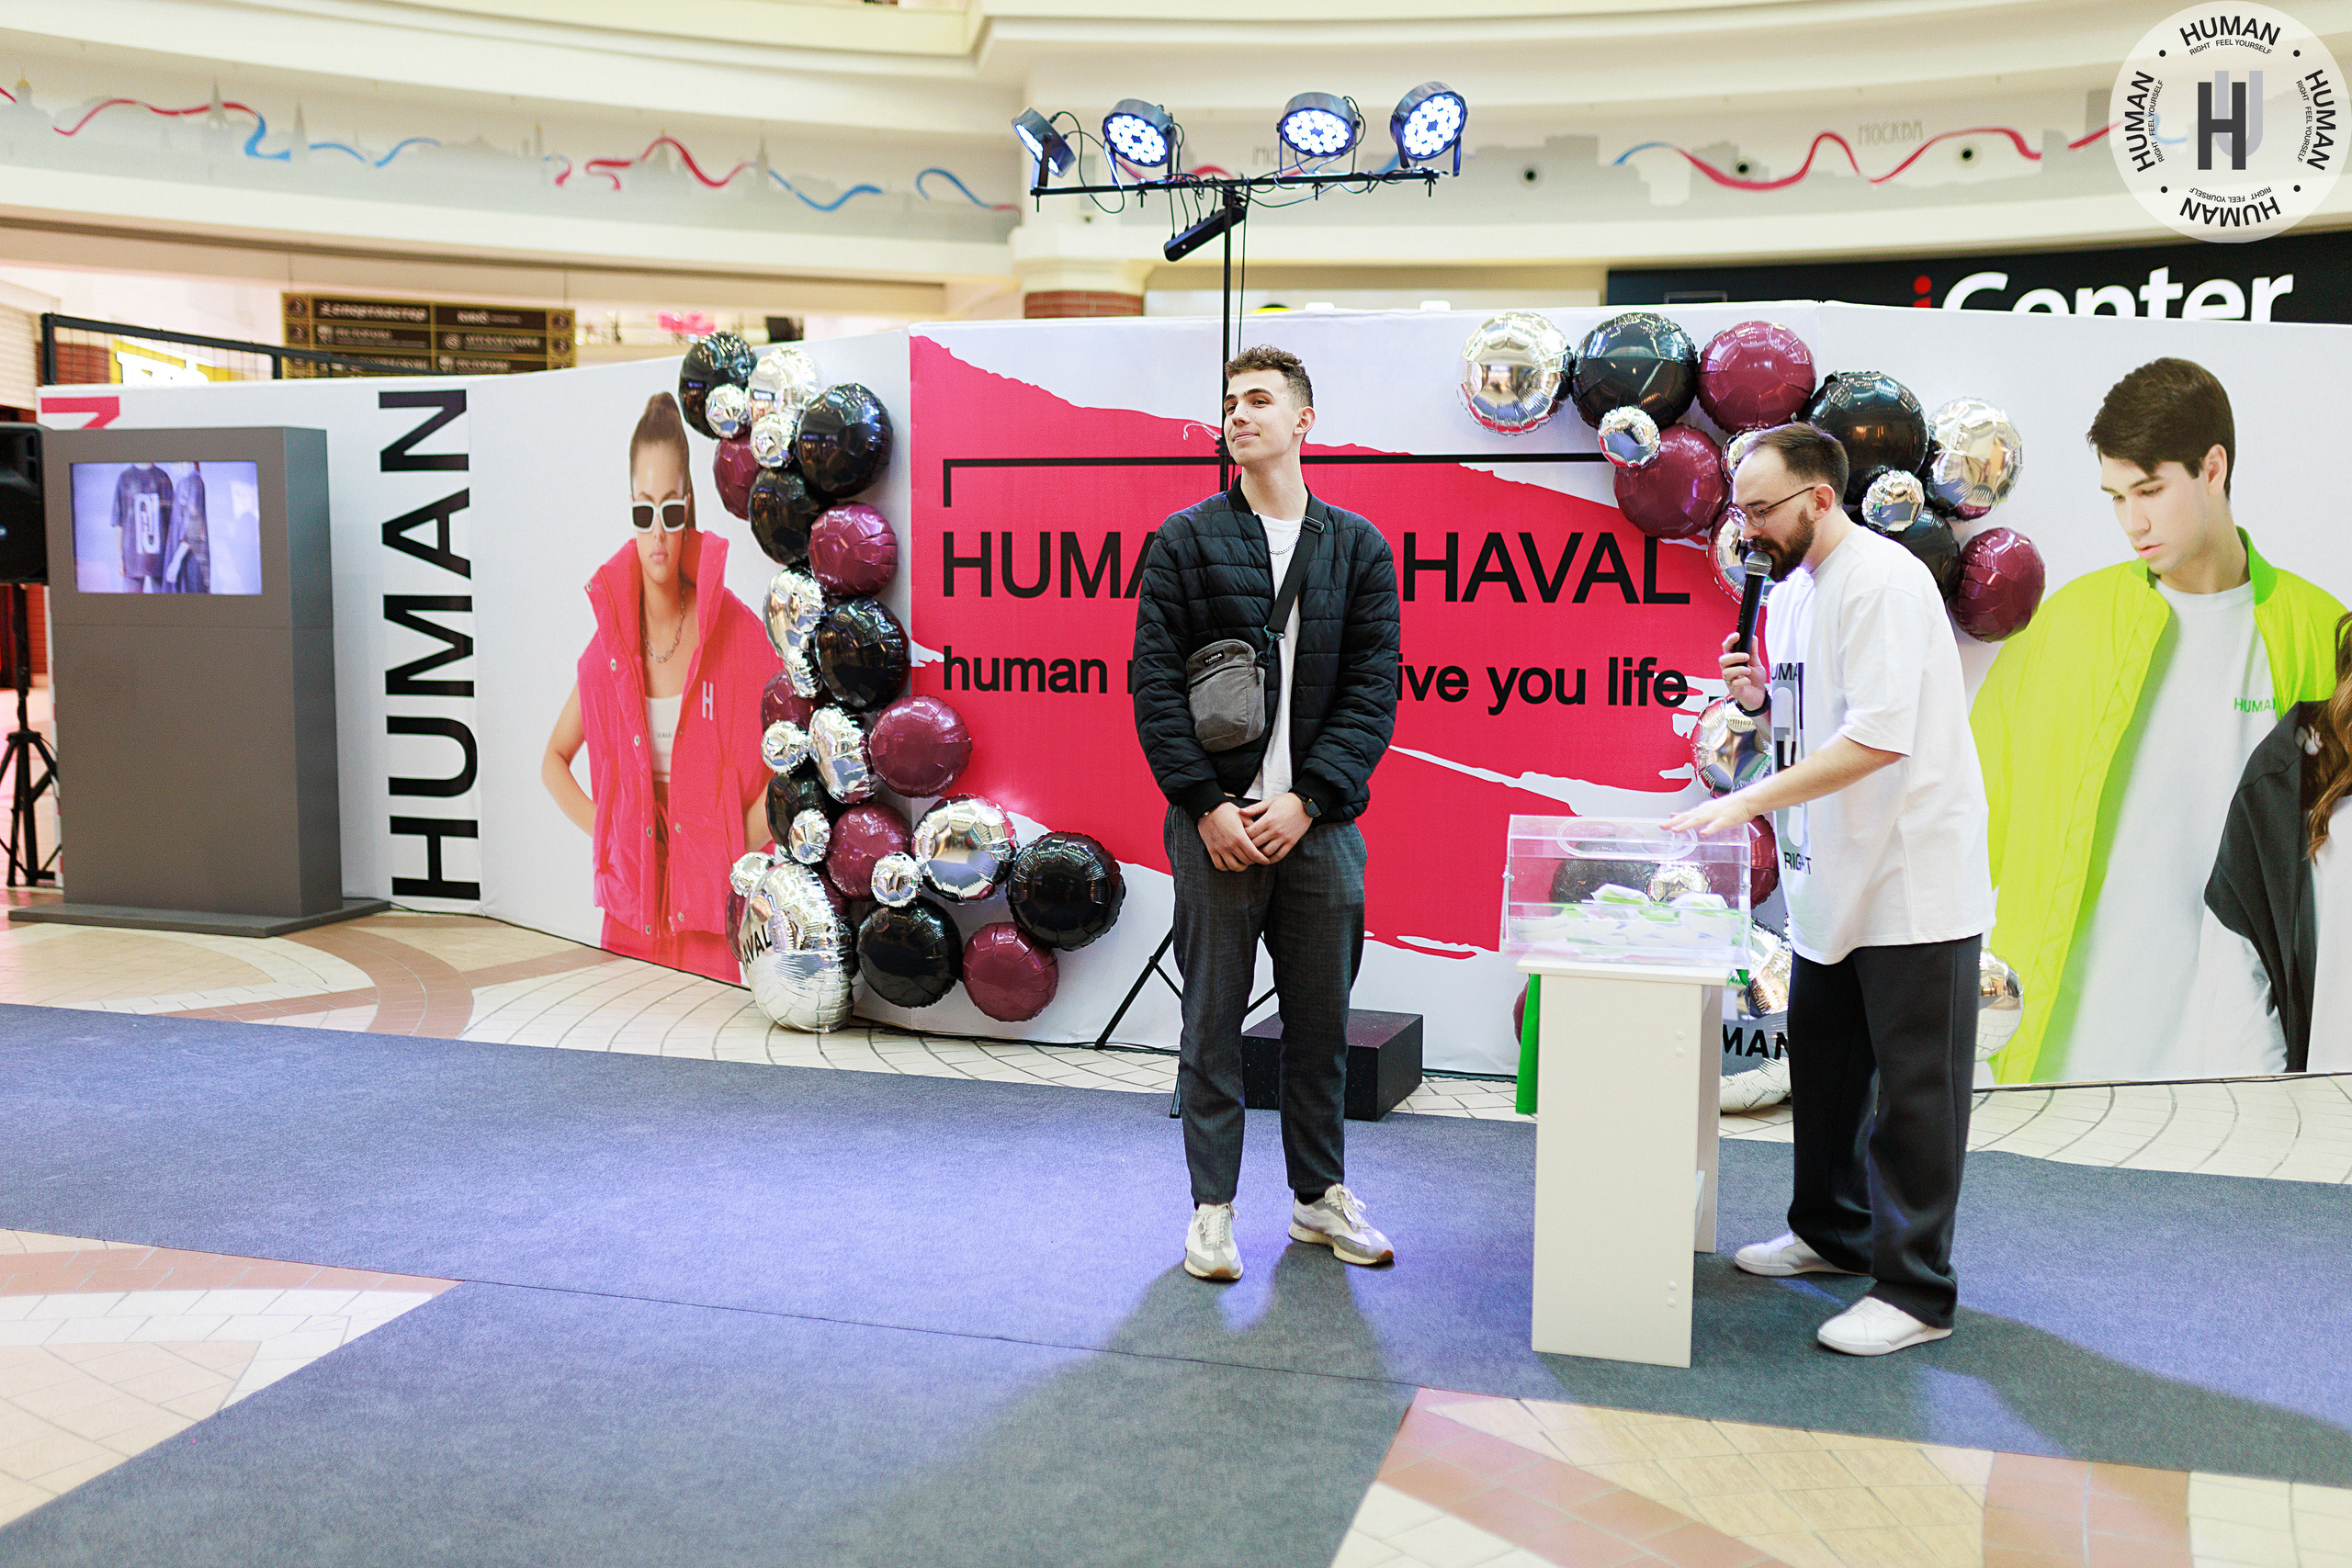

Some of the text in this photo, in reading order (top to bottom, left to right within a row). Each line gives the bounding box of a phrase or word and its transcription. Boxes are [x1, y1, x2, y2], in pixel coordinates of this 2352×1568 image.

[943, 531, 1690, 605] HUM HAVAL
[378, 389, 481, 901] HUMAN
[944, 645, 1108, 694] human
[1396, 652, 1470, 704] ive
[1486, 663, 1587, 716] you
[1608, 656, 1689, 707] life
[1771, 662, 1798, 681] UMA
[701, 681, 714, 721] H
[742, 924, 773, 971] AVAL
[1723, 1023, 1789, 1061] MAN
